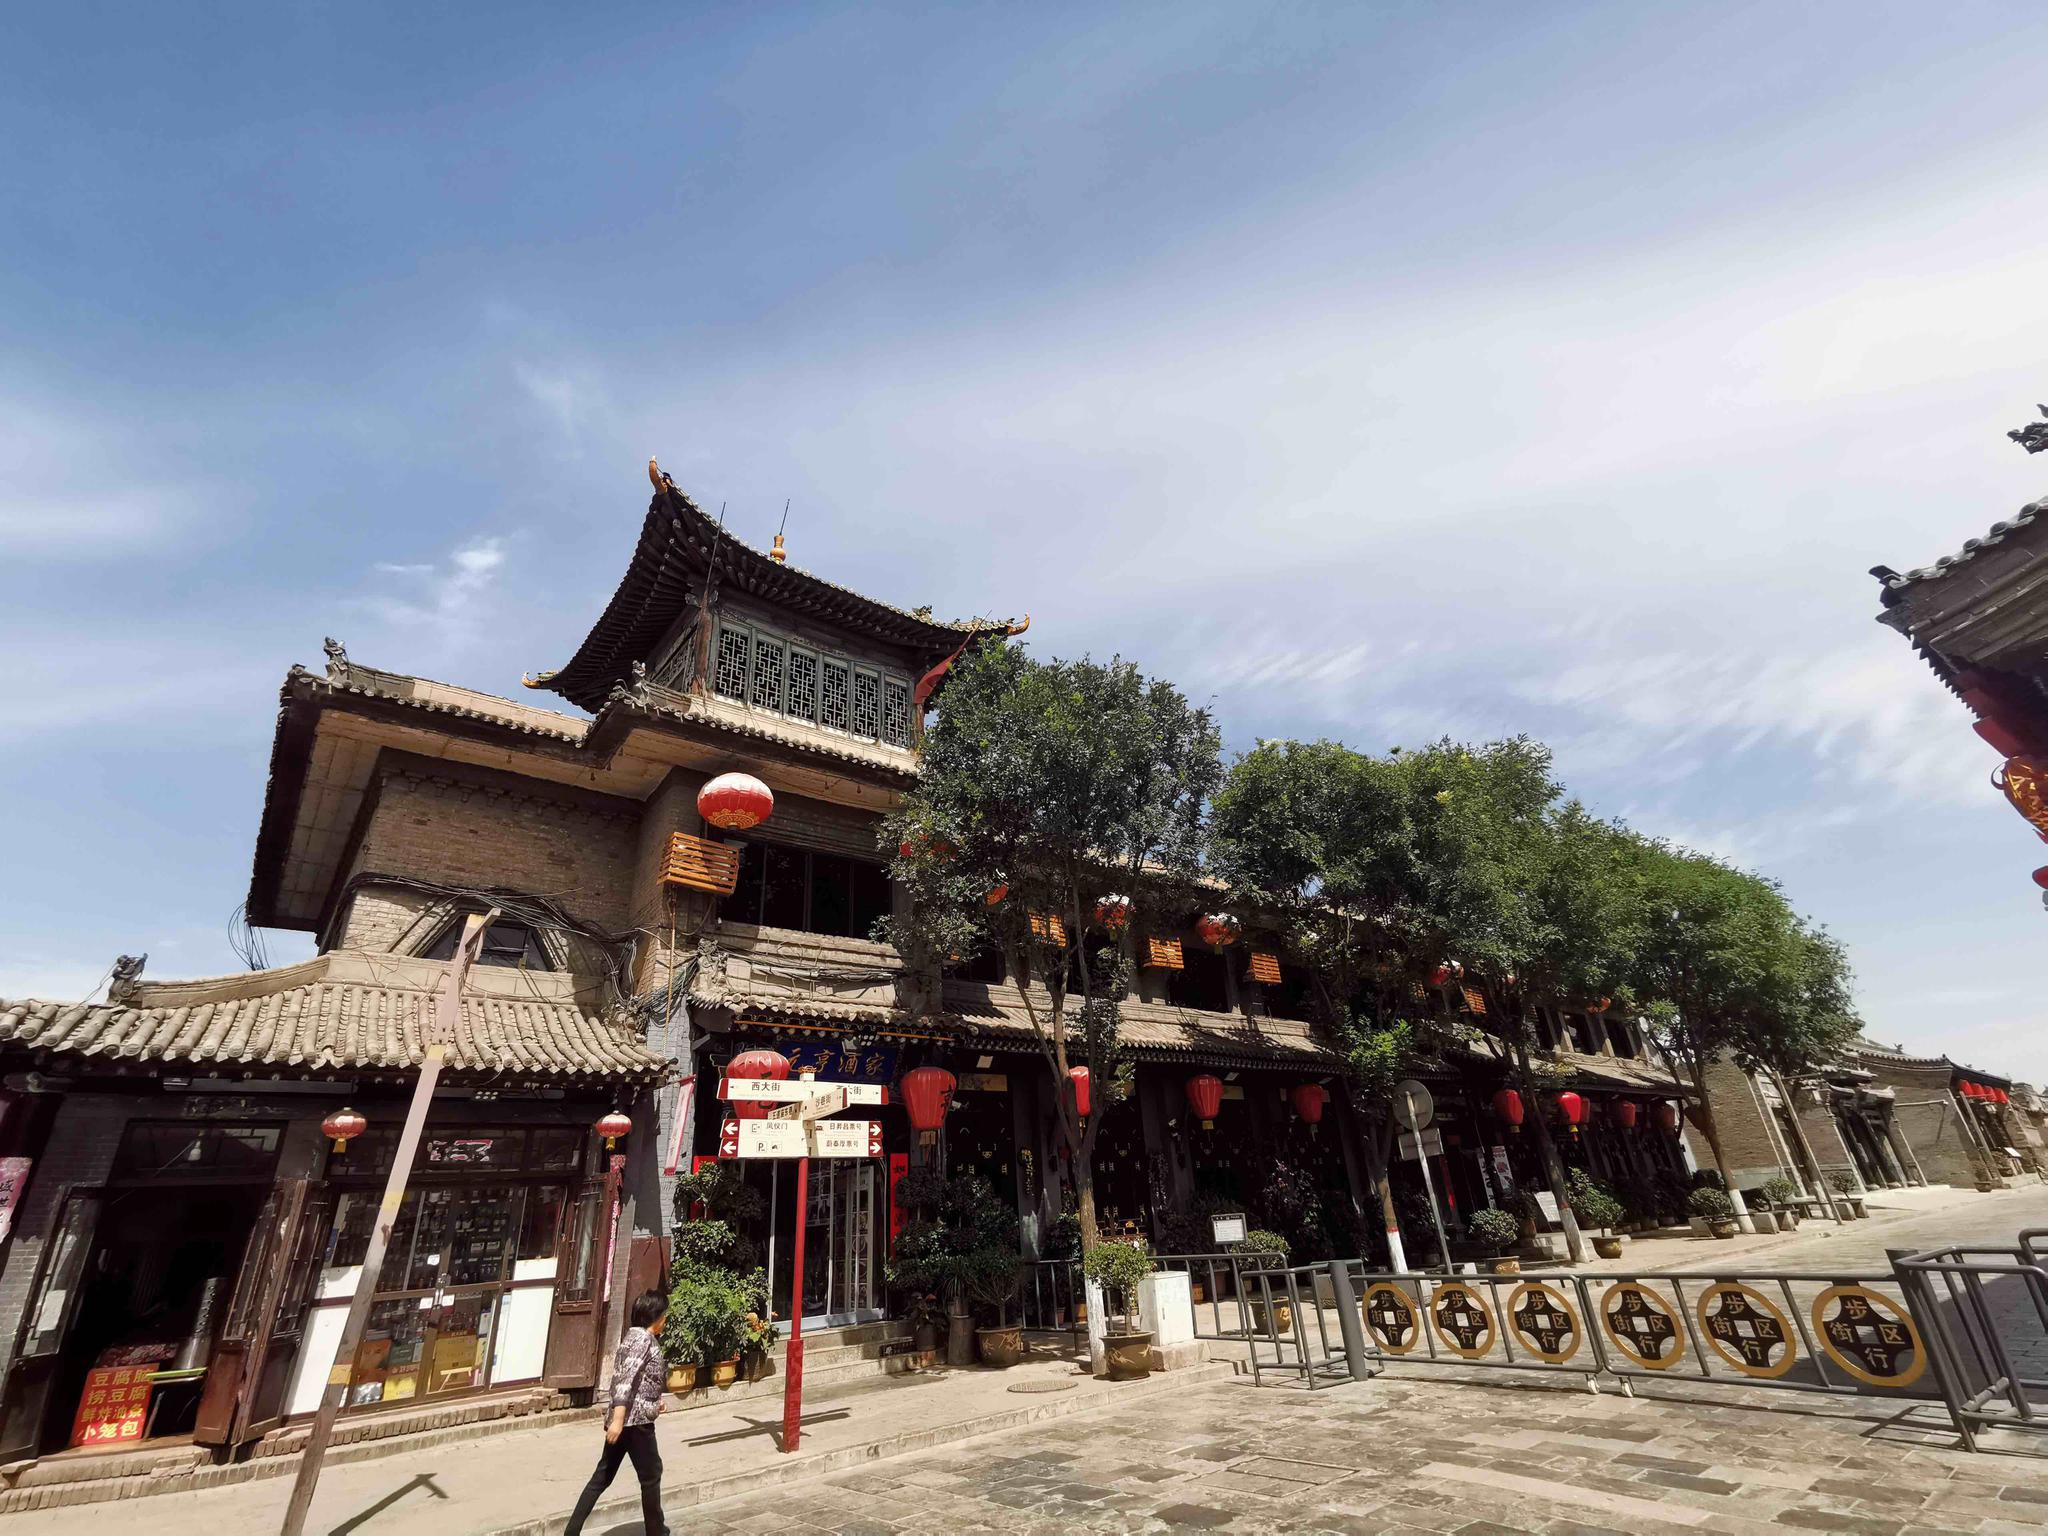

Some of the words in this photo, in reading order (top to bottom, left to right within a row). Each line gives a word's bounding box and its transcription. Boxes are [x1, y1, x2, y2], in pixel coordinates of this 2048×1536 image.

[751, 1081, 781, 1092] 西大街
[92, 1369, 154, 1387] 豆腐脑
[87, 1386, 148, 1405] 捞豆腐
[77, 1420, 139, 1441] 小笼包
